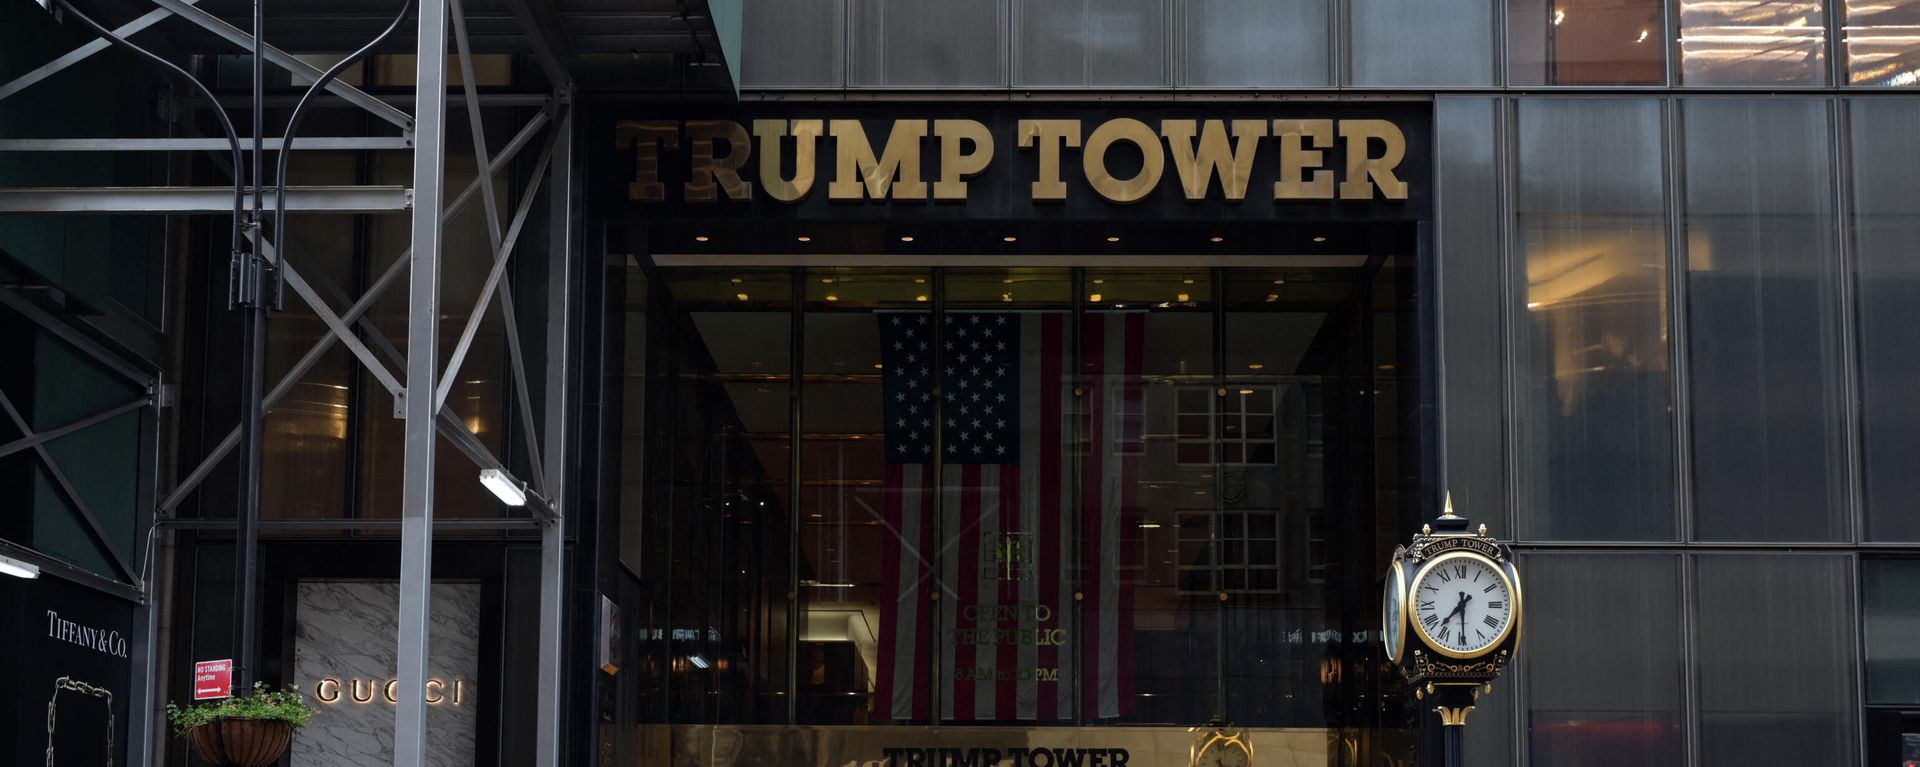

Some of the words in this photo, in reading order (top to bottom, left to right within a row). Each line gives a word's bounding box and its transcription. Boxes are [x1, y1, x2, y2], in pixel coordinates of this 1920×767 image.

[616, 118, 996, 204] TRUMP
[1017, 117, 1409, 204] TOWER
[1424, 540, 1458, 556] TRUMP
[1461, 539, 1494, 555] TOWER
[1436, 568, 1451, 584] XI
[1454, 565, 1467, 579] XII
[1424, 583, 1439, 595] X
[1483, 583, 1497, 594] II
[1488, 601, 1503, 609] III
[963, 604, 1018, 621] OPEN
[1022, 604, 1052, 622] TO
[948, 628, 990, 645] THE
[992, 628, 1067, 646] PUBLIC
[205, 664, 226, 673] STANDING
[966, 668, 992, 681] AM
[1035, 667, 1059, 682] PM
[197, 674, 216, 682] Anytime
[883, 747, 1001, 767] TRUMP
[1008, 747, 1130, 767] TOWER
